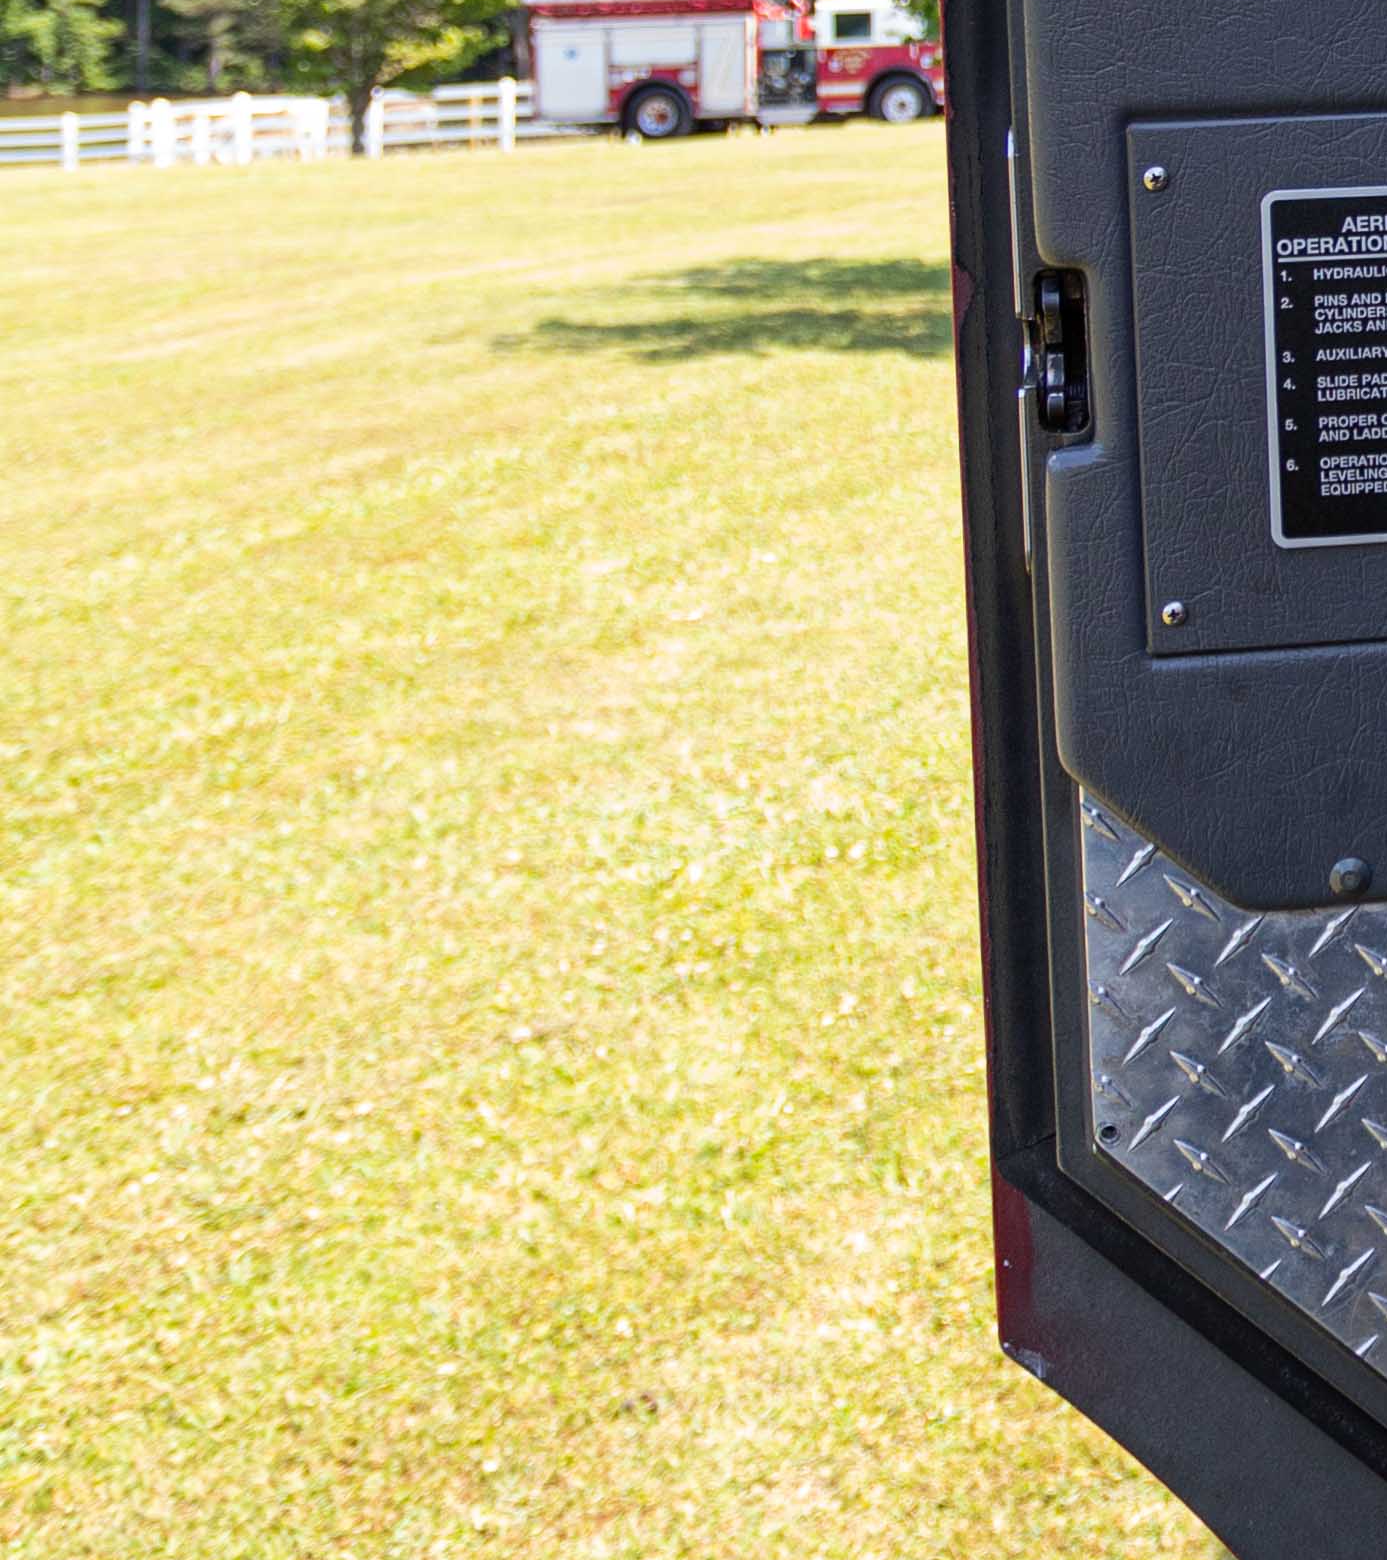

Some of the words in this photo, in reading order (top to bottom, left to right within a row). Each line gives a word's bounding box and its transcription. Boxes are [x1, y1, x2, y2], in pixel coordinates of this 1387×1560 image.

[1280, 269, 1293, 282] 1.
[1280, 296, 1294, 310] 2.
[1314, 293, 1348, 308] PINS
[1350, 292, 1382, 306] AND
[1314, 319, 1363, 335] JACKS
[1282, 350, 1295, 364] 3.
[1283, 377, 1296, 390] 4.
[1317, 374, 1359, 389] SLIDE
[1284, 418, 1298, 431] 5.
[1318, 413, 1378, 429] PROPER
[1318, 429, 1350, 443] AND
[1286, 458, 1299, 472] 6.
